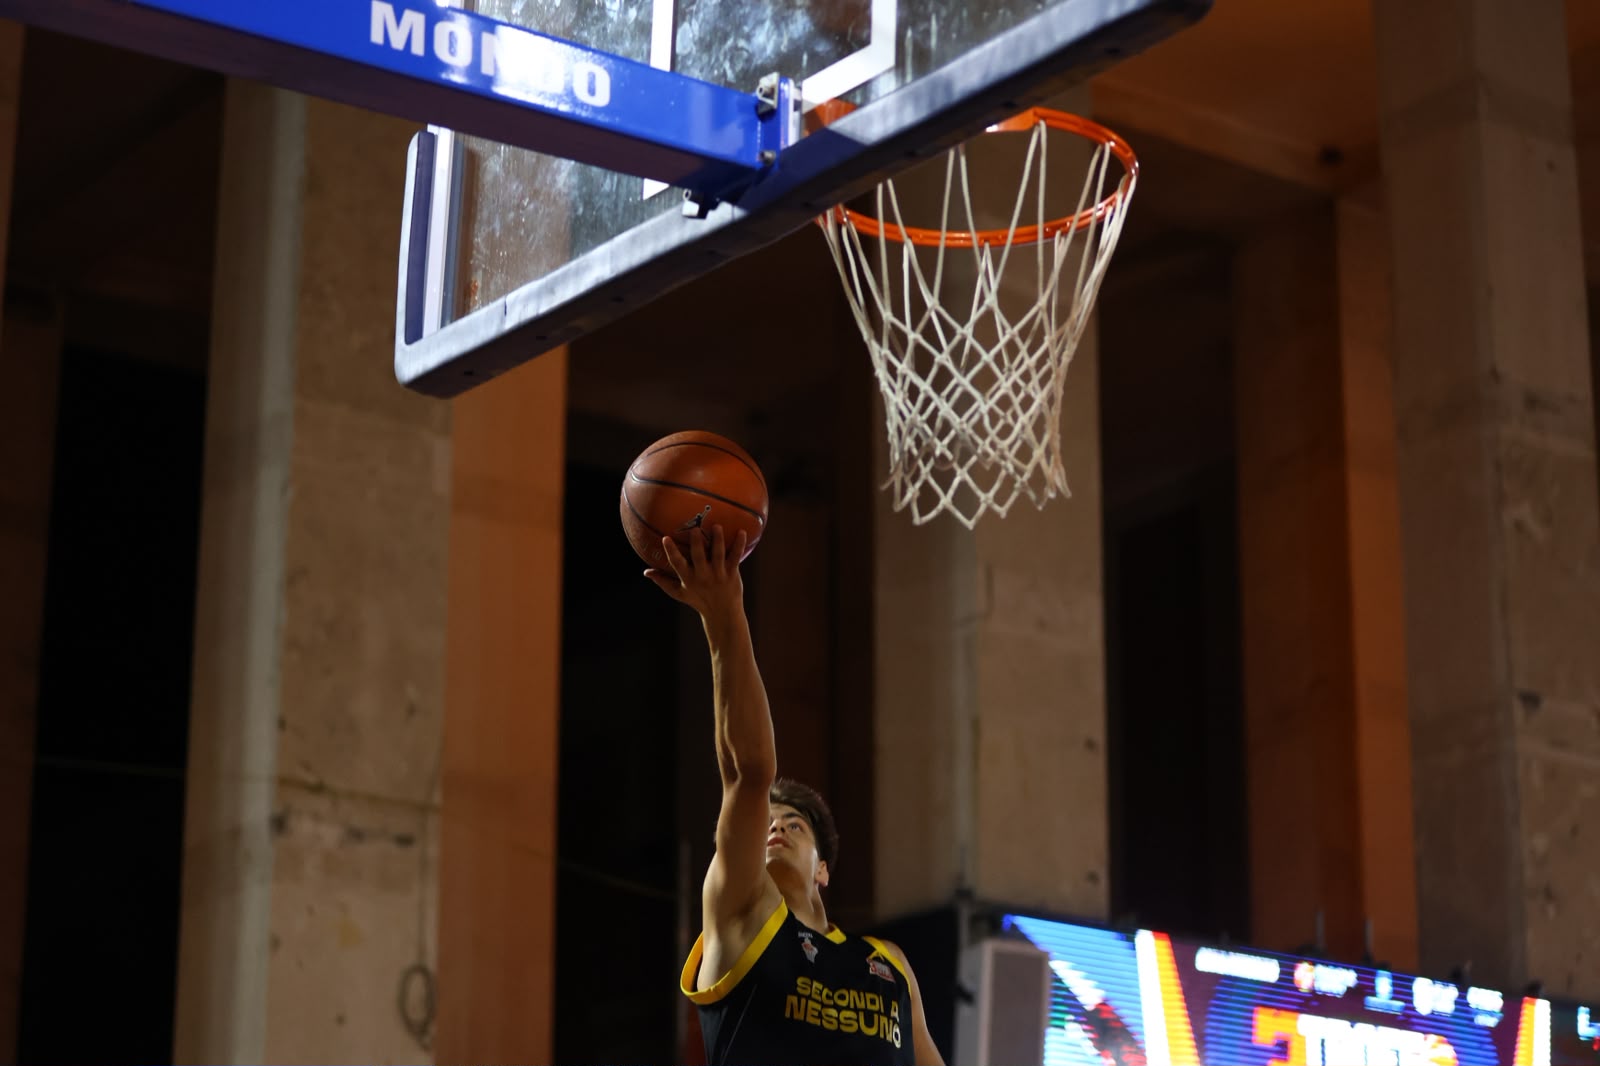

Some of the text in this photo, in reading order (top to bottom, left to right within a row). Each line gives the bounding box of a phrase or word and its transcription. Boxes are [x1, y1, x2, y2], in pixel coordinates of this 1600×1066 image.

[786, 995, 901, 1048] NESSUNO
[797, 977, 900, 1022] SECONDI A
